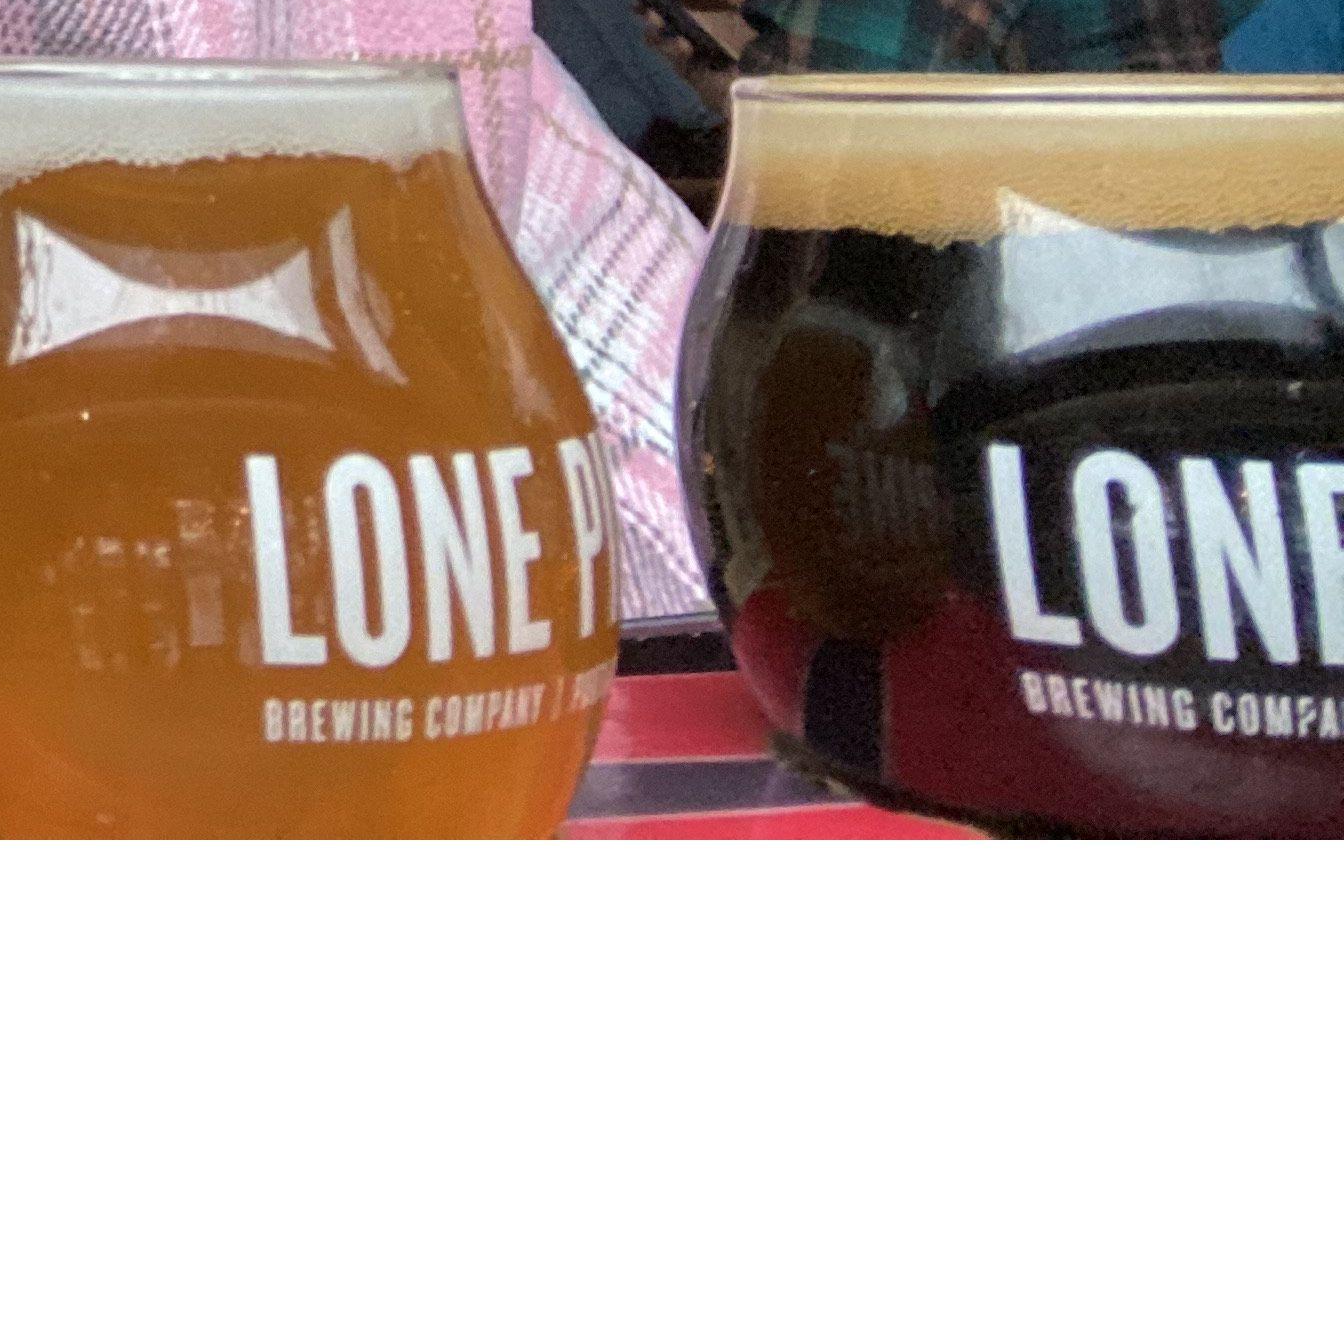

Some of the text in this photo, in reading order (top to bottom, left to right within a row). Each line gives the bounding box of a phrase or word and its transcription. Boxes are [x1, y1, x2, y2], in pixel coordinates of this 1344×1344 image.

[242, 446, 553, 670] LONE
[262, 696, 414, 743] BREWING
[422, 681, 546, 742] COMPANY
[1018, 670, 1344, 741] BREWING COMPA
